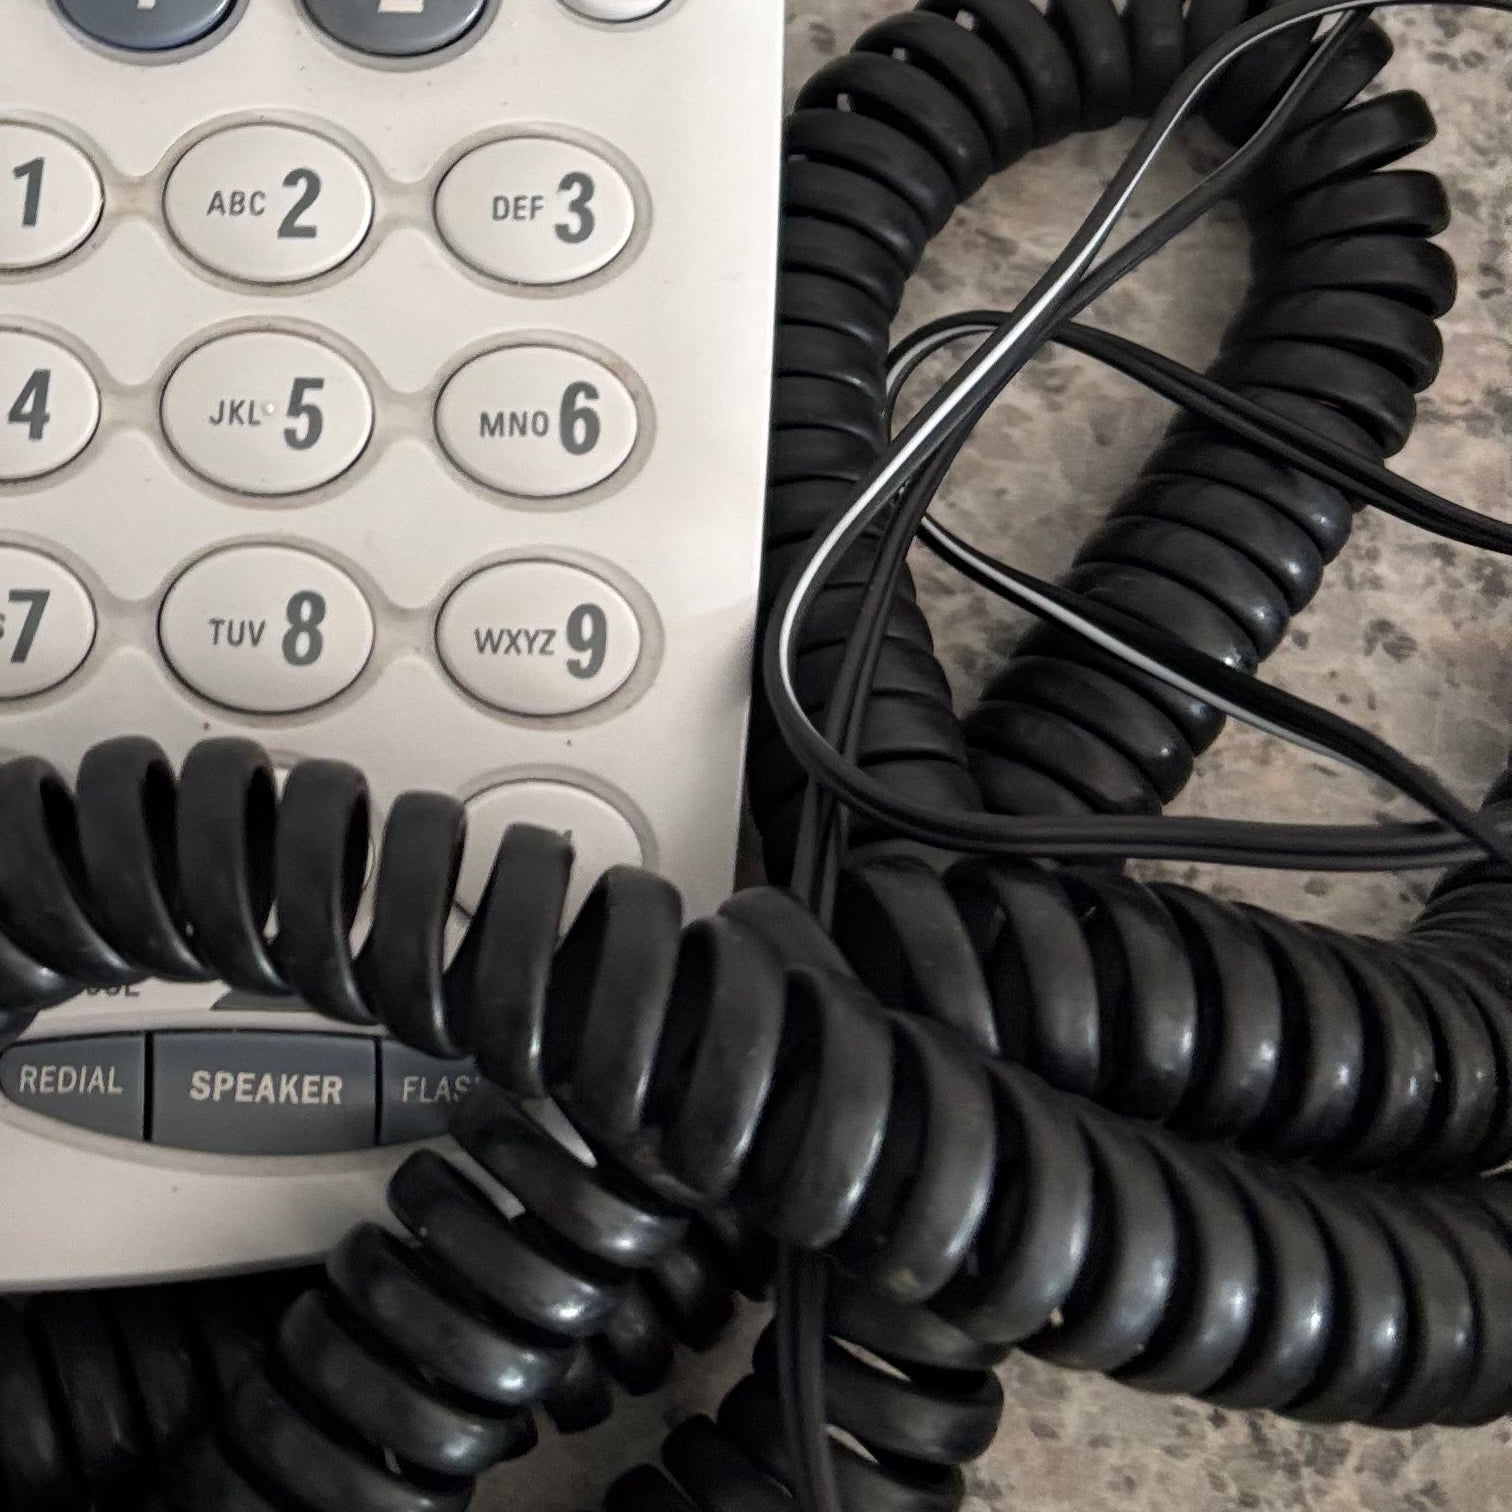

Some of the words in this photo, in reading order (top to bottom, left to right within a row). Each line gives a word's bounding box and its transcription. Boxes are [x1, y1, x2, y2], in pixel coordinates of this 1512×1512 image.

[12, 157, 45, 227] 1
[206, 190, 266, 217] ABC
[277, 167, 322, 239] 2
[492, 195, 543, 221] DEF
[554, 171, 595, 244] 3
[7, 369, 51, 441] 4
[209, 399, 262, 426] JKL
[283, 377, 325, 451] 5
[479, 410, 549, 438] MNO
[559, 381, 601, 456] 6
[8, 589, 51, 665] 7
[209, 617, 266, 647] TUV
[280, 590, 326, 667] 8
[473, 627, 556, 656] WXYZ
[566, 603, 608, 680] 9
[19, 1065, 123, 1094] REDIAL
[189, 1070, 343, 1105] SPEAKER
[402, 1074, 481, 1104] FLAS
